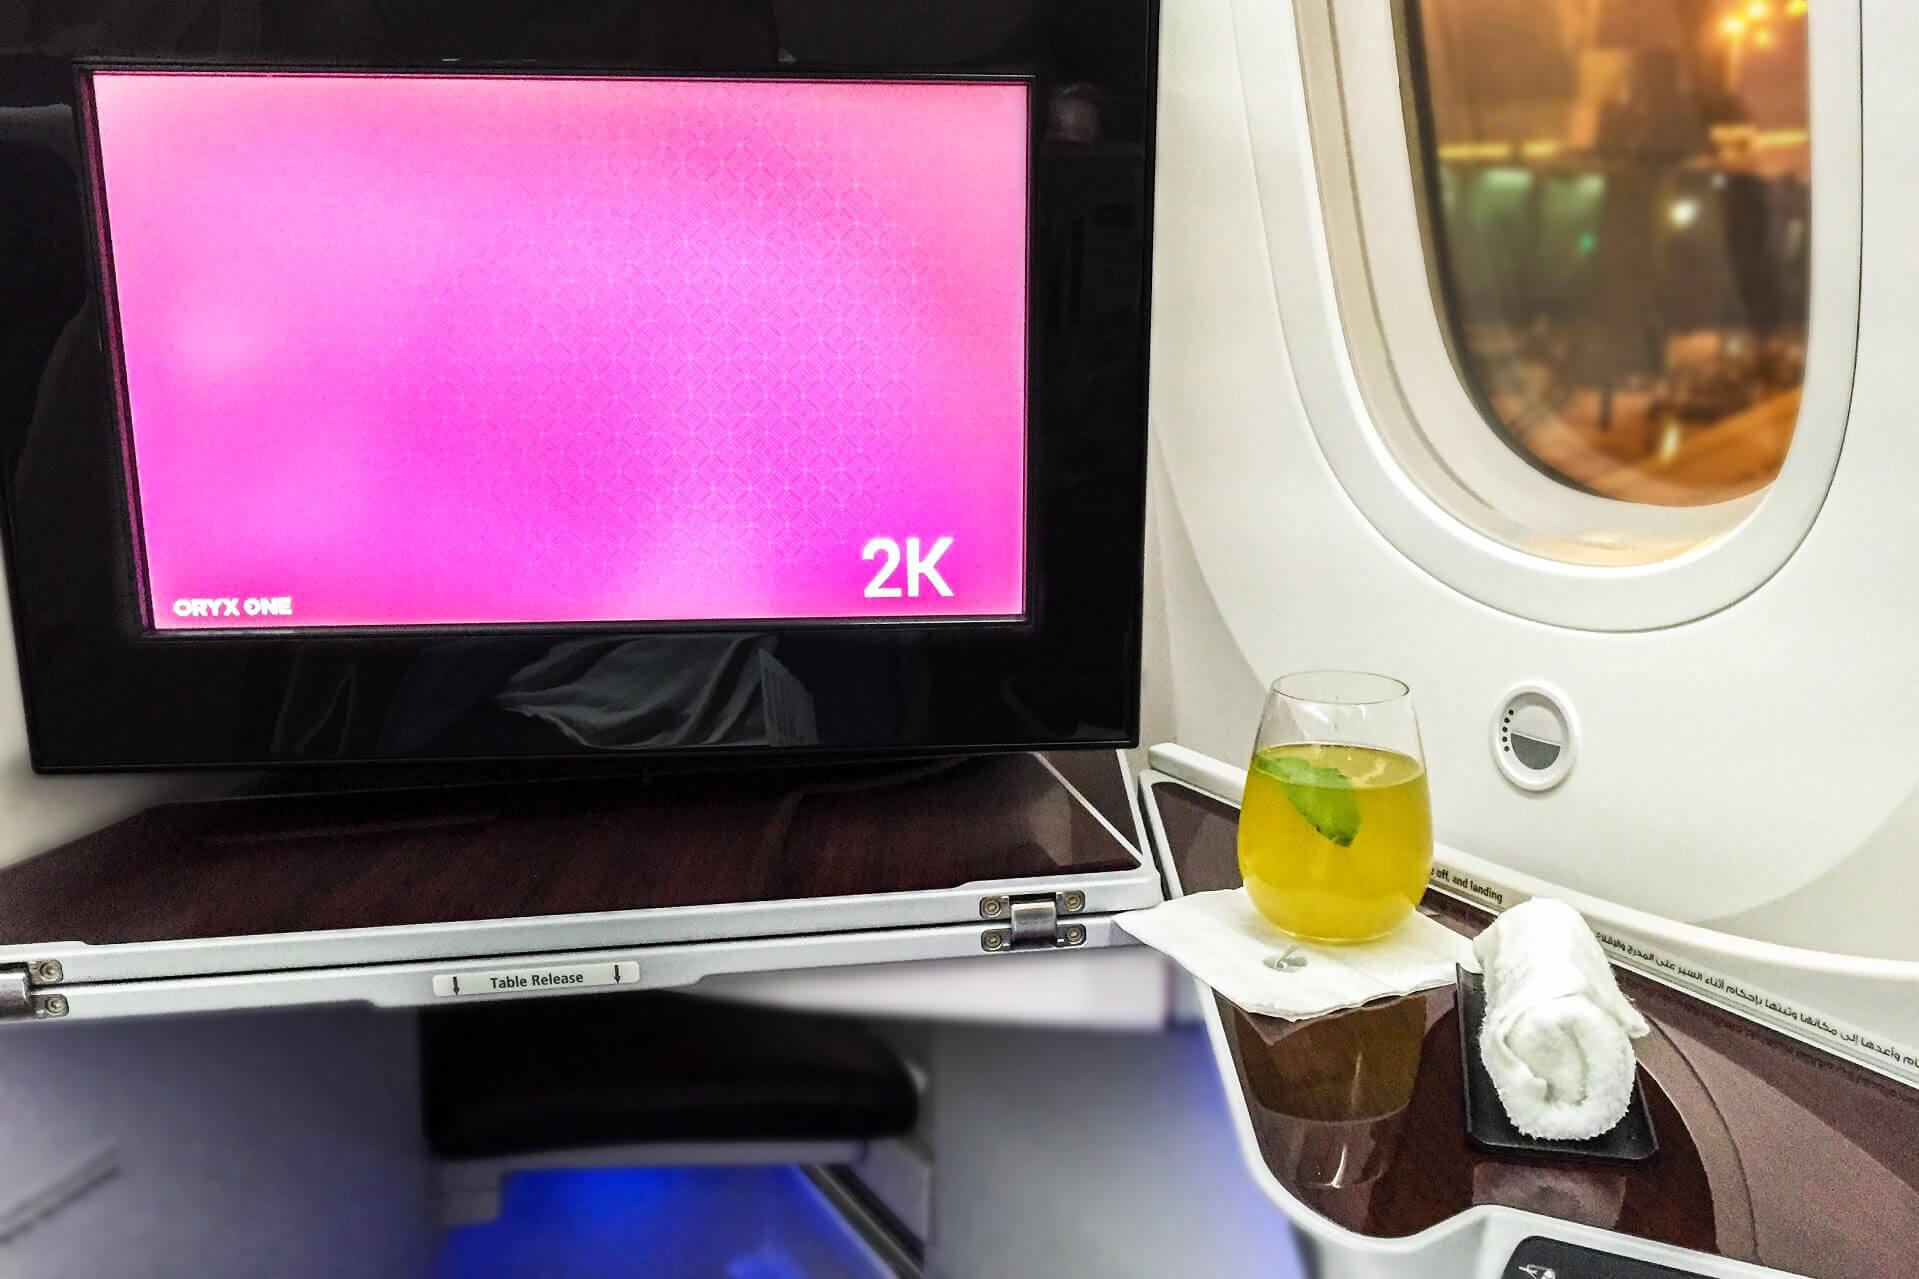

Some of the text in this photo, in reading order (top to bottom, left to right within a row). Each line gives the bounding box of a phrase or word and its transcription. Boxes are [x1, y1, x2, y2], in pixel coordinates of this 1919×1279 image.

[862, 536, 954, 598] 2K
[173, 596, 293, 617] ORYX ONE
[1452, 876, 1468, 888] and
[1470, 880, 1503, 905] landing
[1655, 958, 1676, 971] على
[490, 973, 584, 990] Table Release
[1800, 1012, 1838, 1036] مكانها
